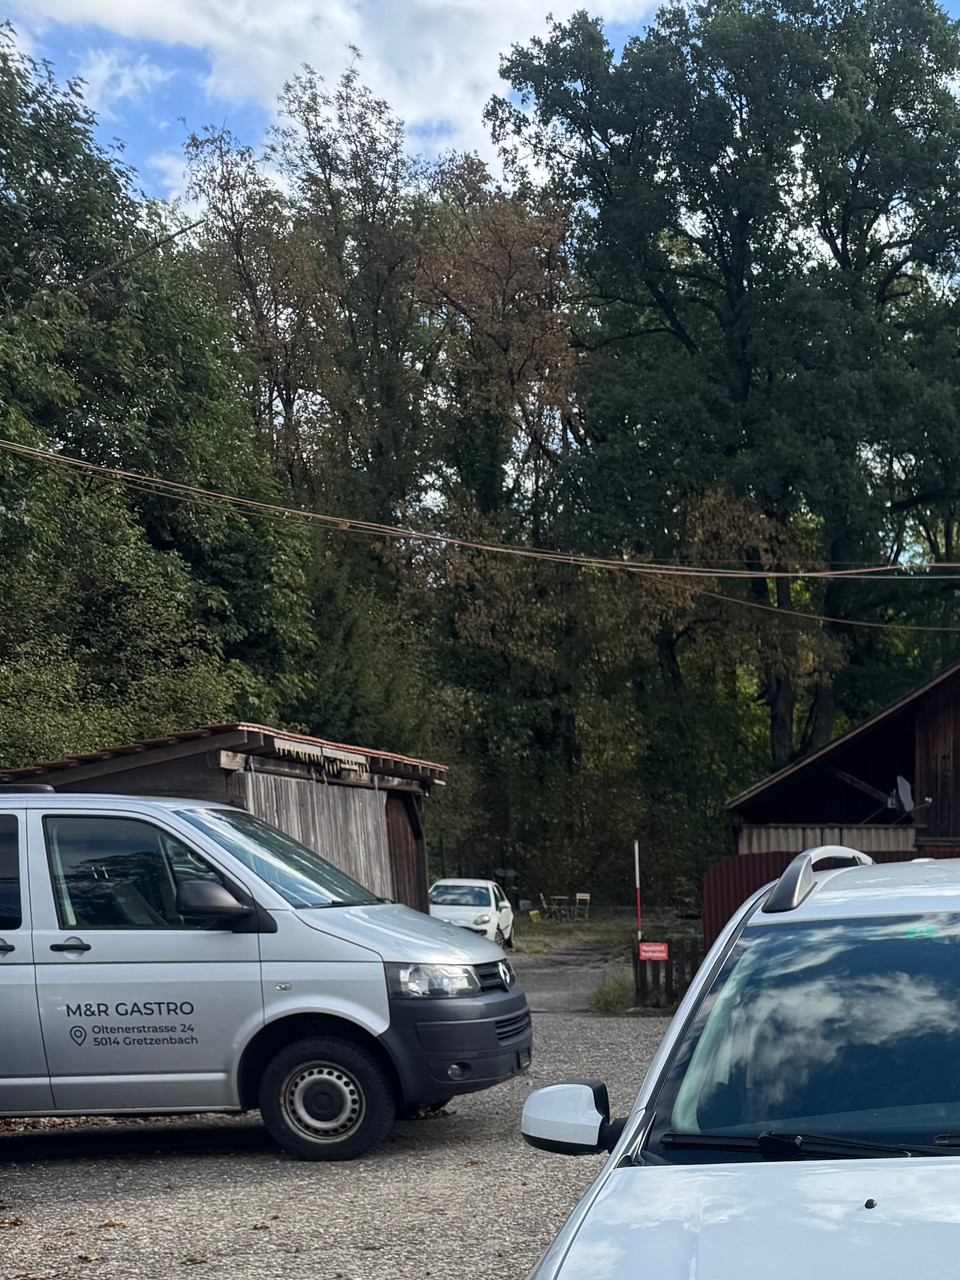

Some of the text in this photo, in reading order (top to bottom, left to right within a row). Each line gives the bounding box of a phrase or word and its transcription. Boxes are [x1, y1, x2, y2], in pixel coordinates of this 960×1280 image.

[66, 1001, 194, 1017] M&R GASTRO
[92, 1023, 195, 1034] Oltenerstrasse 24
[93, 1035, 199, 1046] 5014 Gretzenbach
